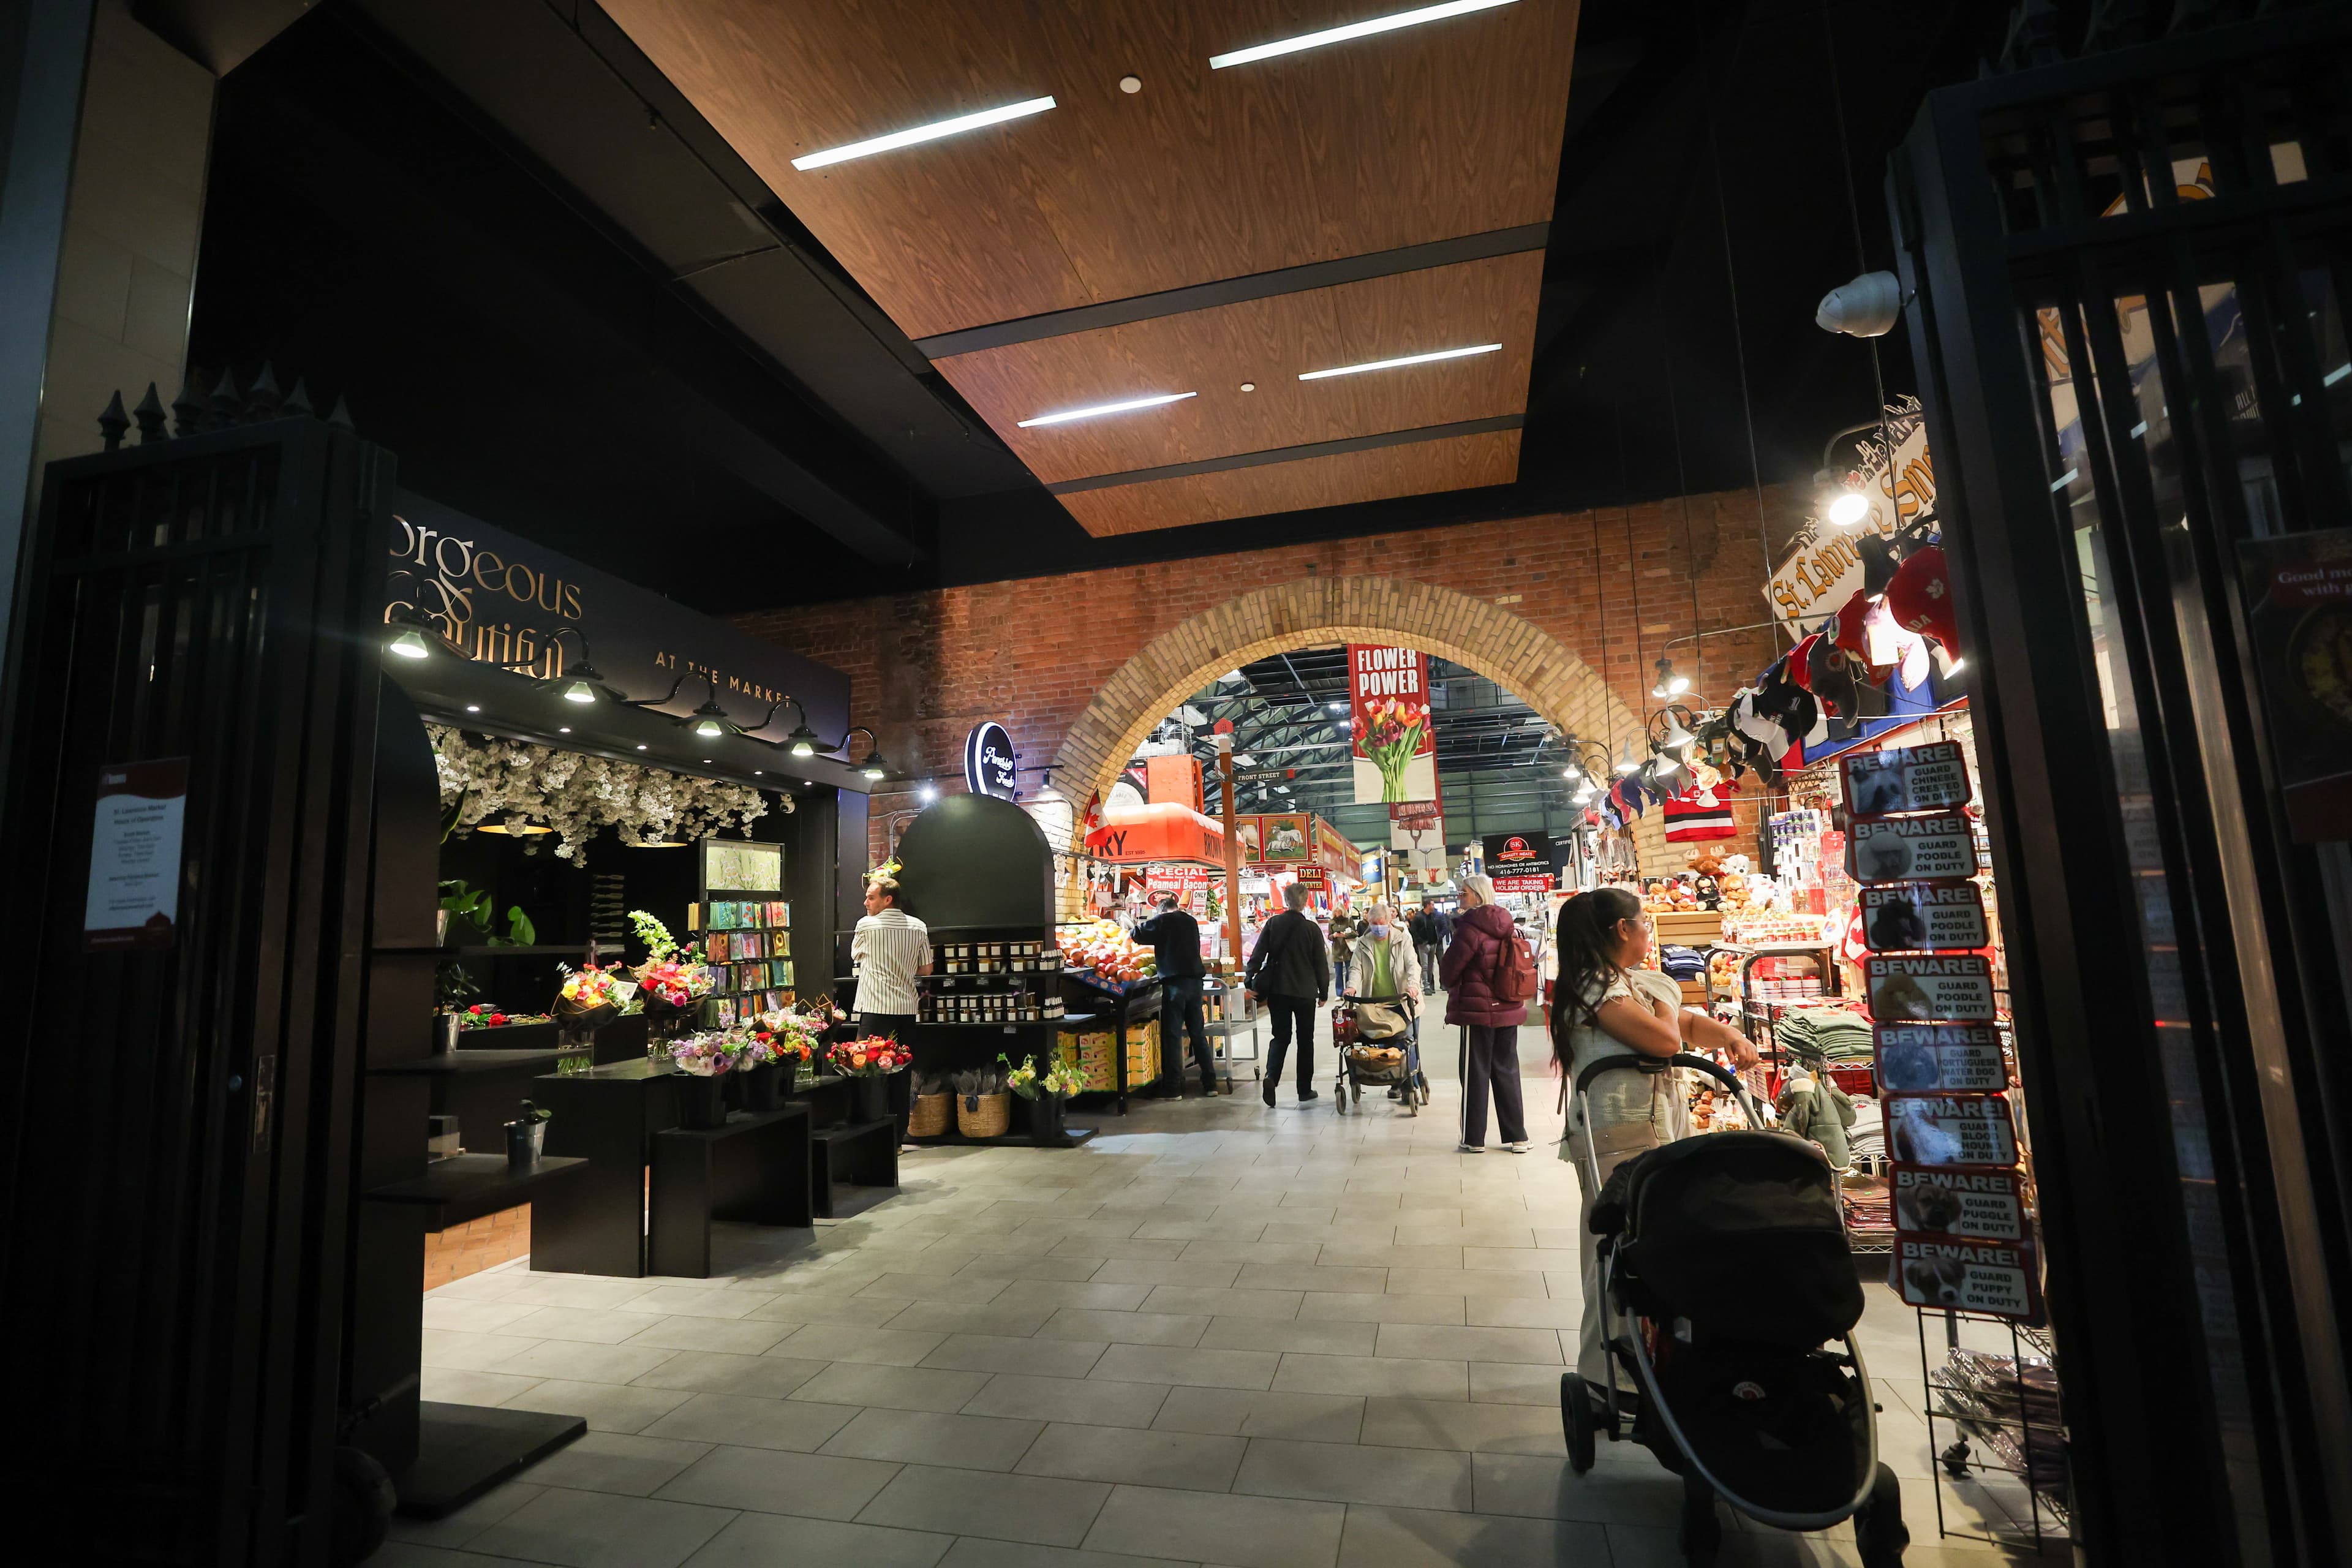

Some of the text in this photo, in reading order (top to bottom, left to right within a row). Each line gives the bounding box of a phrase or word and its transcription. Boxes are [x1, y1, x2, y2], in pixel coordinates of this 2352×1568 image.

[1796, 501, 1893, 603] Lawree
[390, 514, 582, 620] orgeous
[2278, 568, 2324, 584] Good
[2302, 582, 2340, 596] with
[1357, 647, 1417, 672] FLOWER
[655, 650, 793, 708] AT THE MARKET
[1359, 669, 1419, 696] POWER
[1847, 744, 1958, 773] BEWARE!
[1914, 764, 1951, 777] GUARD
[1911, 773, 1958, 786] CHINESE
[1913, 790, 1961, 803] ON DUTY
[1854, 818, 1966, 839] BEWARE!
[1204, 832, 1222, 861] BROWN
[1918, 840, 1958, 851] GUARD
[1917, 851, 1962, 862] POODLE
[1147, 867, 1207, 876] SPECIAL
[1299, 869, 1322, 878] DELI
[1915, 861, 1966, 873] ON DUTY
[1147, 878, 1207, 889] Peameal Bacon
[1865, 888, 1975, 908] BEWARE!
[1932, 910, 1972, 919] GUARD
[1931, 921, 1976, 930] POODLE
[1929, 931, 1980, 941] ON DUTY
[1870, 959, 1985, 976] BEWARE!
[1938, 981, 1979, 990] GUARD
[1936, 992, 1983, 1002] POODLE
[1935, 1003, 1988, 1013] ON DUTY
[1880, 1028, 1995, 1046] BEWARE!
[1950, 1048, 1983, 1057] GUARD
[1939, 1058, 1999, 1067] PORTUGUESE
[1941, 1067, 1996, 1076] WATER DOG
[1949, 1076, 1991, 1085] ON DUTY
[1890, 1099, 2005, 1118] BEWARE!
[1959, 1122, 1999, 1131] GUARD
[1961, 1131, 2000, 1141] BLOOD
[1962, 1141, 2003, 1150] HOUND
[1959, 1150, 2008, 1161] ON DUTY
[1899, 1171, 2013, 1193] BEWARE!
[1964, 1197, 2007, 1210] GUARD
[1963, 1208, 2012, 1221] PUGGLE
[1962, 1220, 2015, 1234] ON DUTY
[1902, 1242, 2021, 1267] BEWARE!
[1970, 1270, 2013, 1283] GUARD
[1972, 1283, 2013, 1295] PUPPY
[1967, 1293, 2021, 1309] ON DUTY
